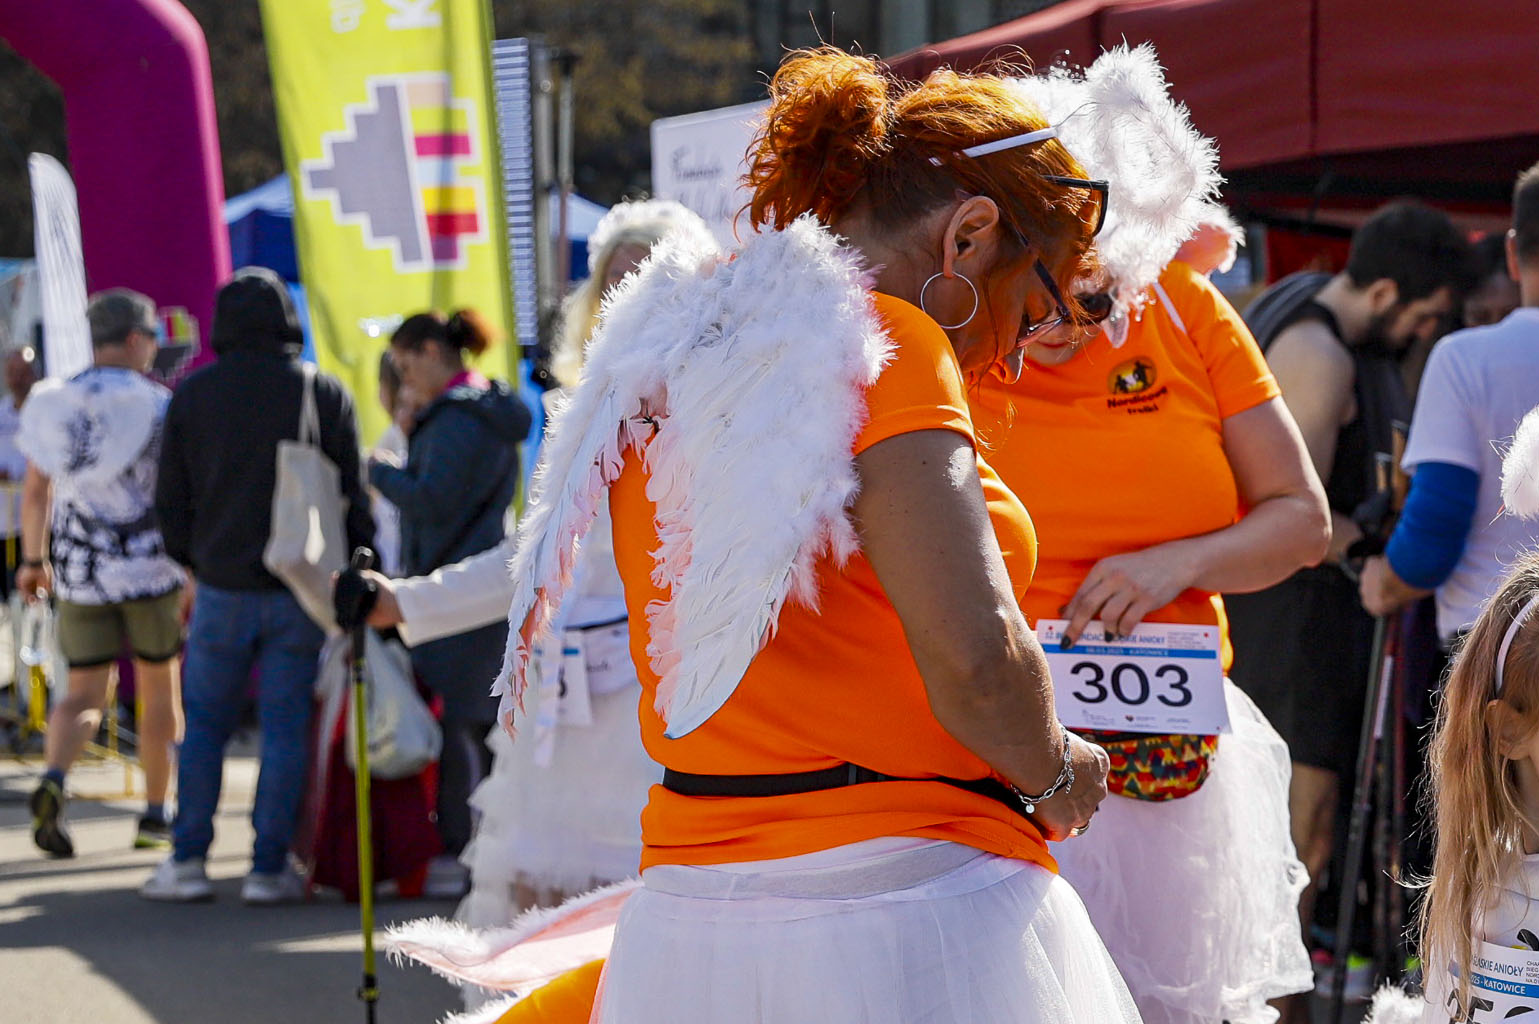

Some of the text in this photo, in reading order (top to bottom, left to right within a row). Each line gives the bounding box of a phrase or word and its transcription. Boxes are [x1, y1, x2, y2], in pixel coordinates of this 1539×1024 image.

[1070, 661, 1193, 707] 303
[1493, 961, 1525, 977] ANIOŁY
[1483, 975, 1527, 995] KATOWICE
